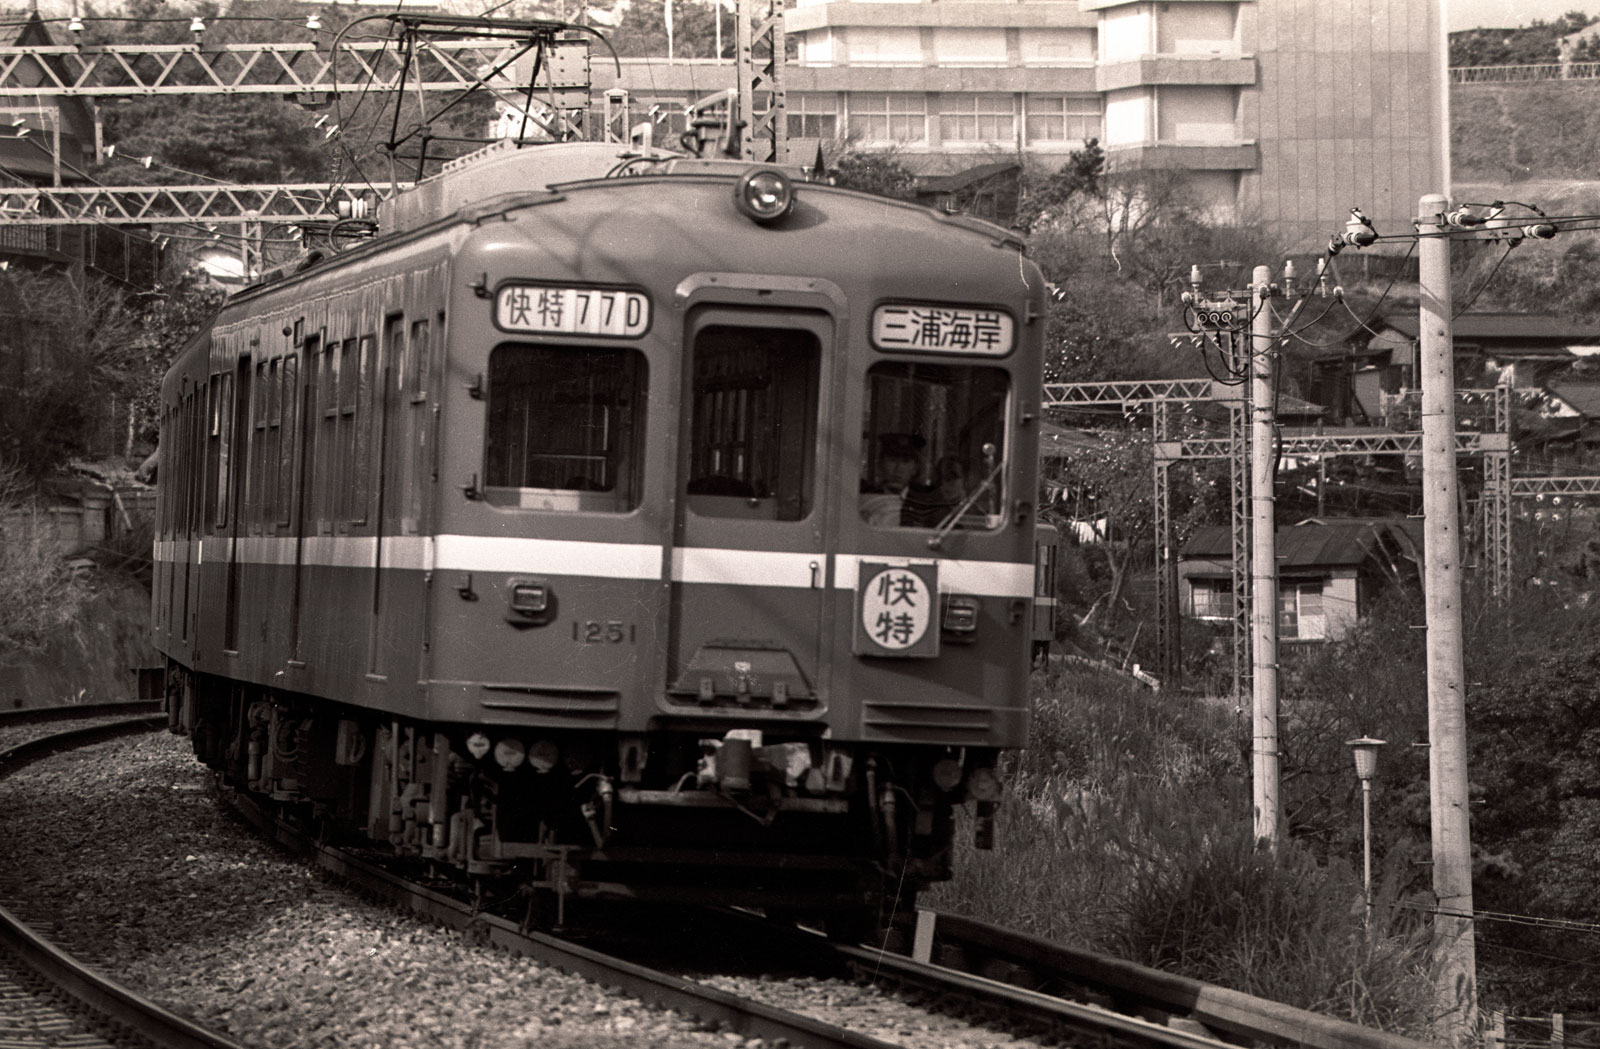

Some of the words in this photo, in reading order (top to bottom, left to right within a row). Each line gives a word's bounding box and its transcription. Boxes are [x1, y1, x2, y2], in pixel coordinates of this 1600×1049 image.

[506, 288, 563, 327] 快特
[880, 309, 1002, 350] 三浦海岸
[876, 573, 918, 644] 快特
[572, 621, 637, 645] 1251
